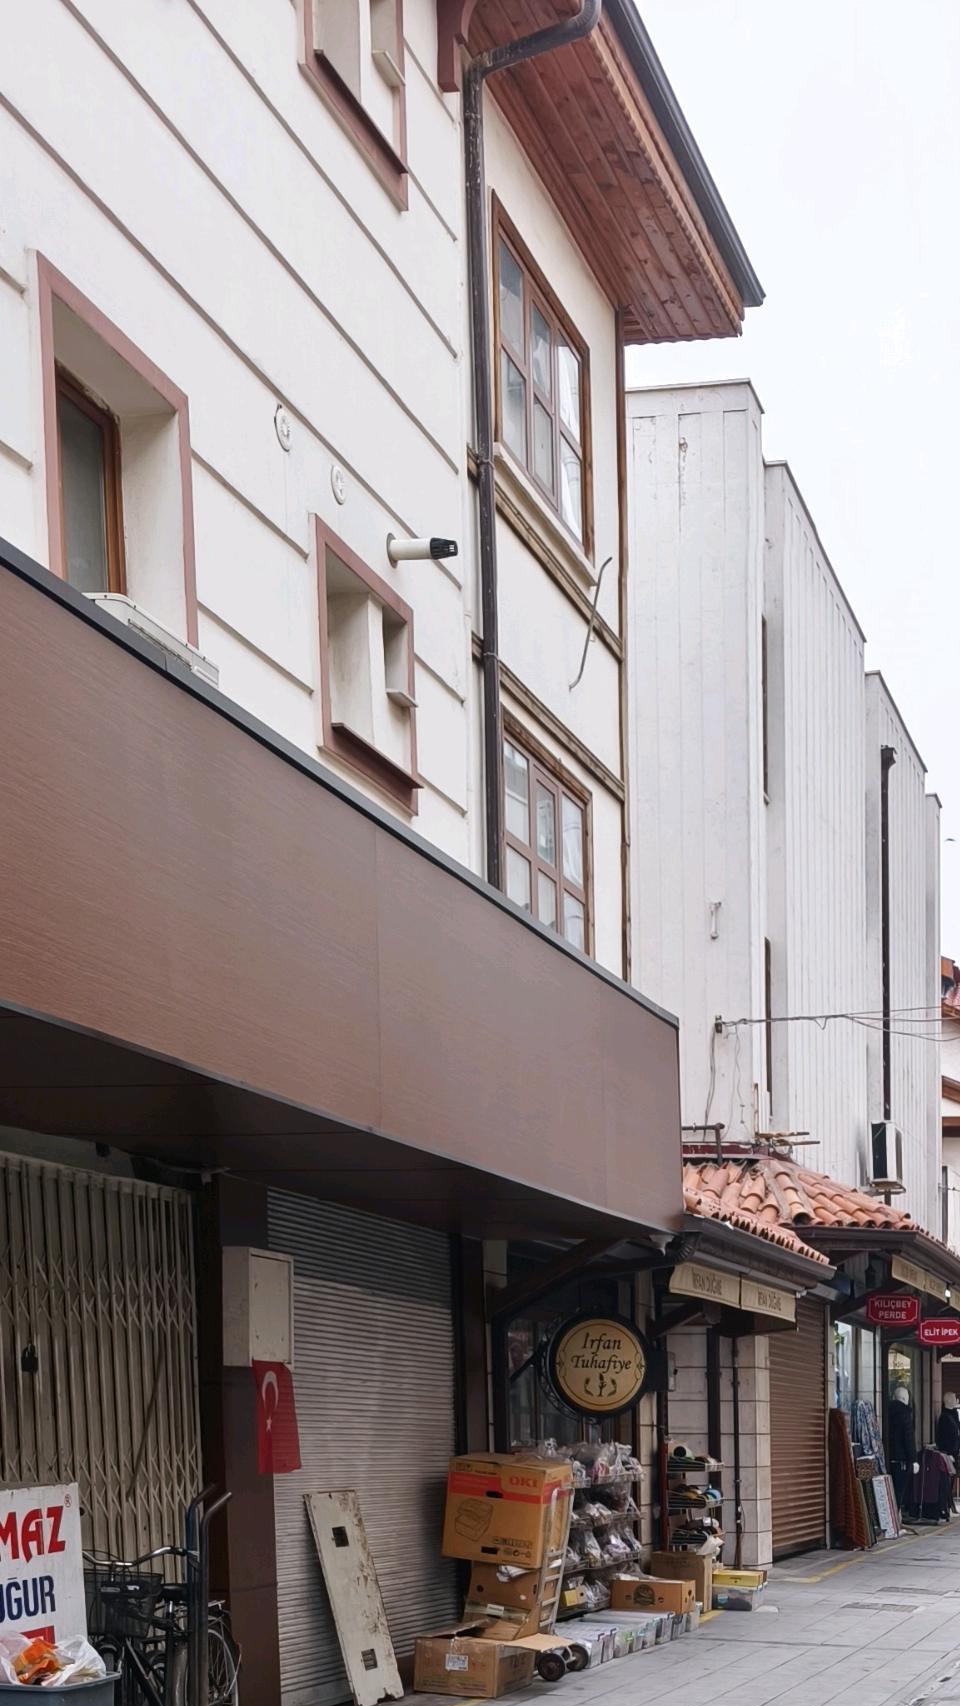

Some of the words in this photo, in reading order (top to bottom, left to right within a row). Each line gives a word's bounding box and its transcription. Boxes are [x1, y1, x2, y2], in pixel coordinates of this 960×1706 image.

[878, 1310, 907, 1320] PERDE
[571, 1354, 631, 1374] Tuhafiye
[510, 1475, 538, 1488] OKI
[0, 1575, 56, 1624] ĞUR
